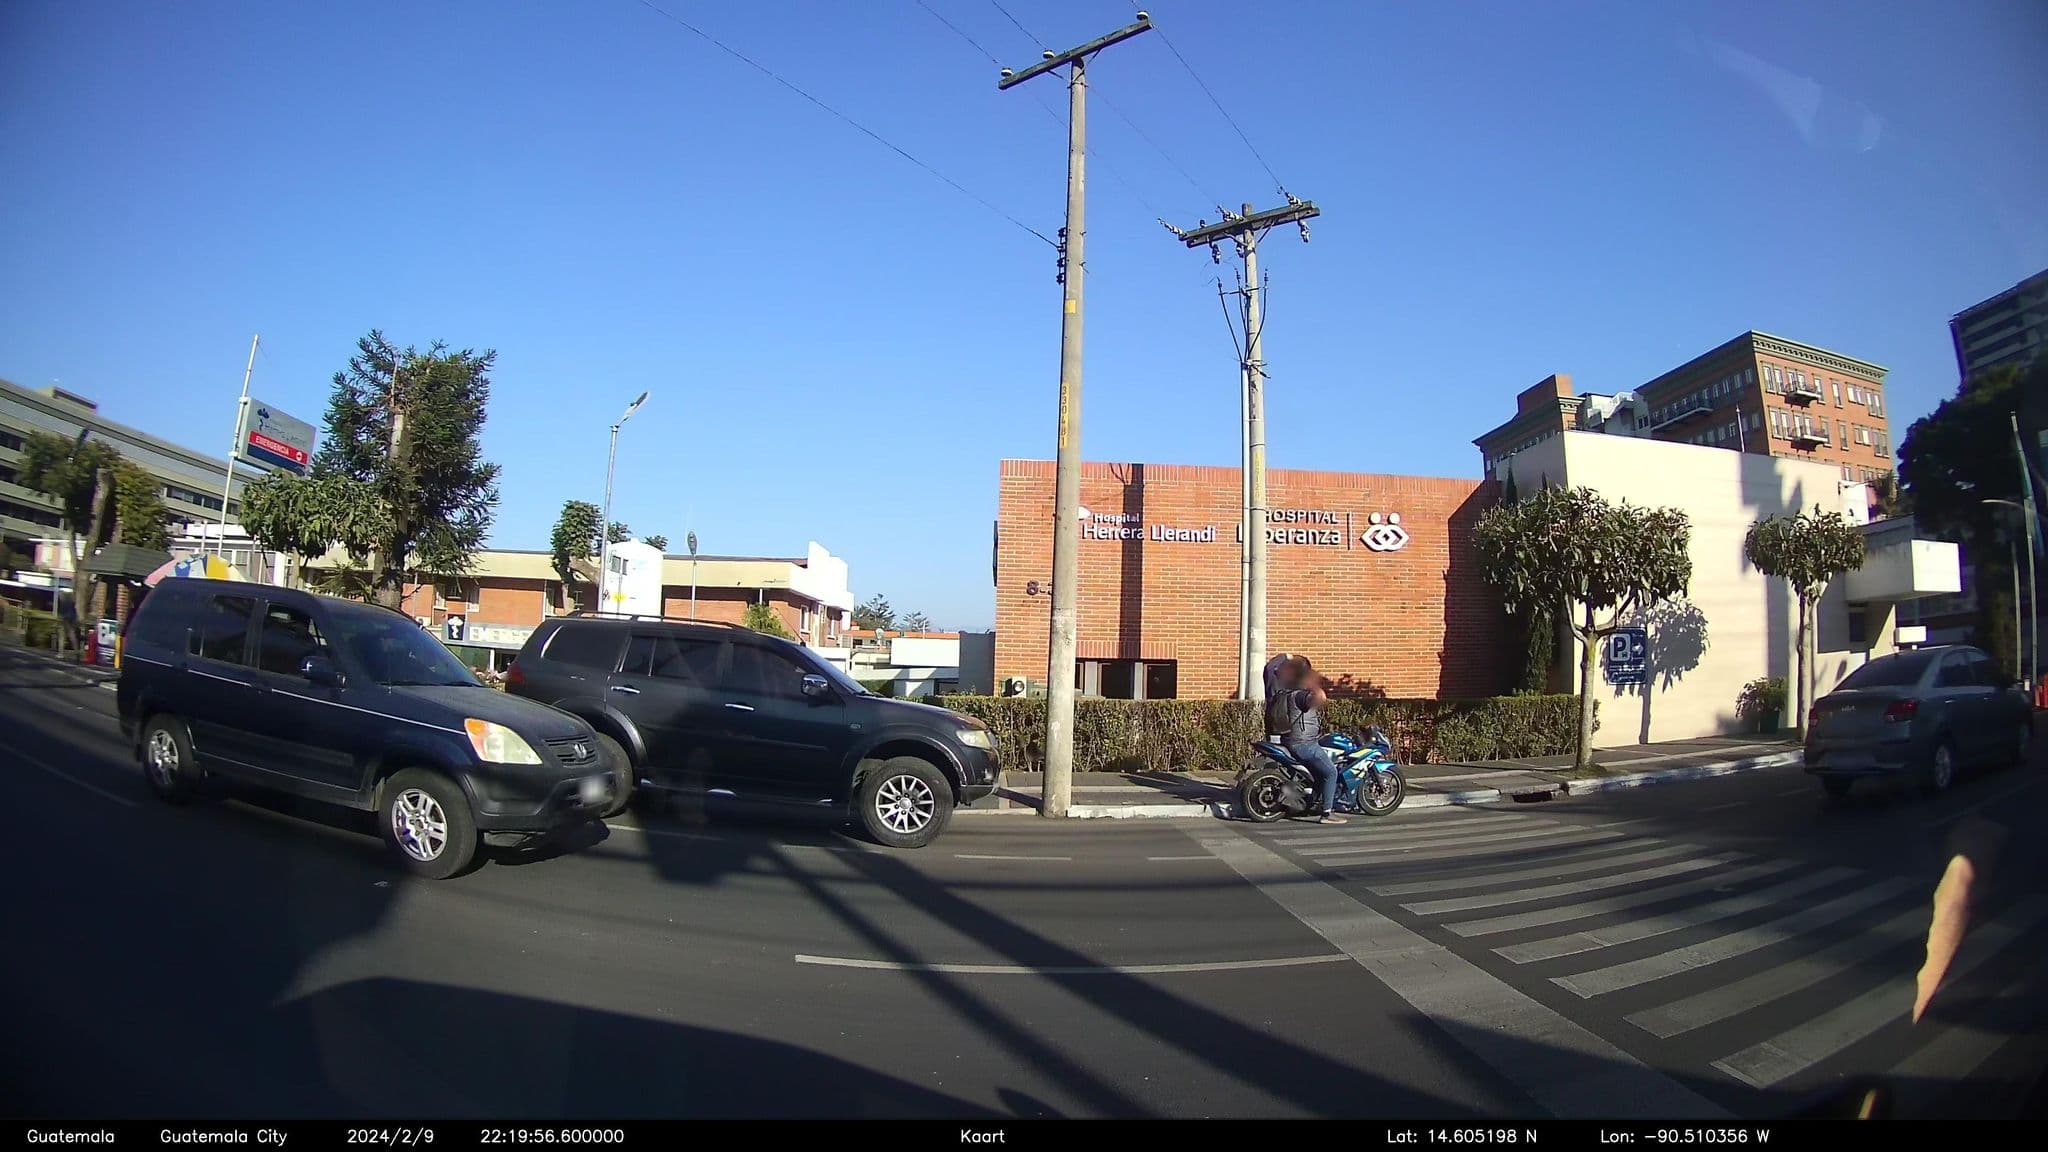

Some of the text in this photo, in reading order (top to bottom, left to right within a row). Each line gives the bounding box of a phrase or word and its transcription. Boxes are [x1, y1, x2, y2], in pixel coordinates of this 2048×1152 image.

[1094, 512, 1140, 525] Hospital
[1083, 524, 1217, 542] Herrera Llerandi
[1236, 522, 1341, 545] peranza
